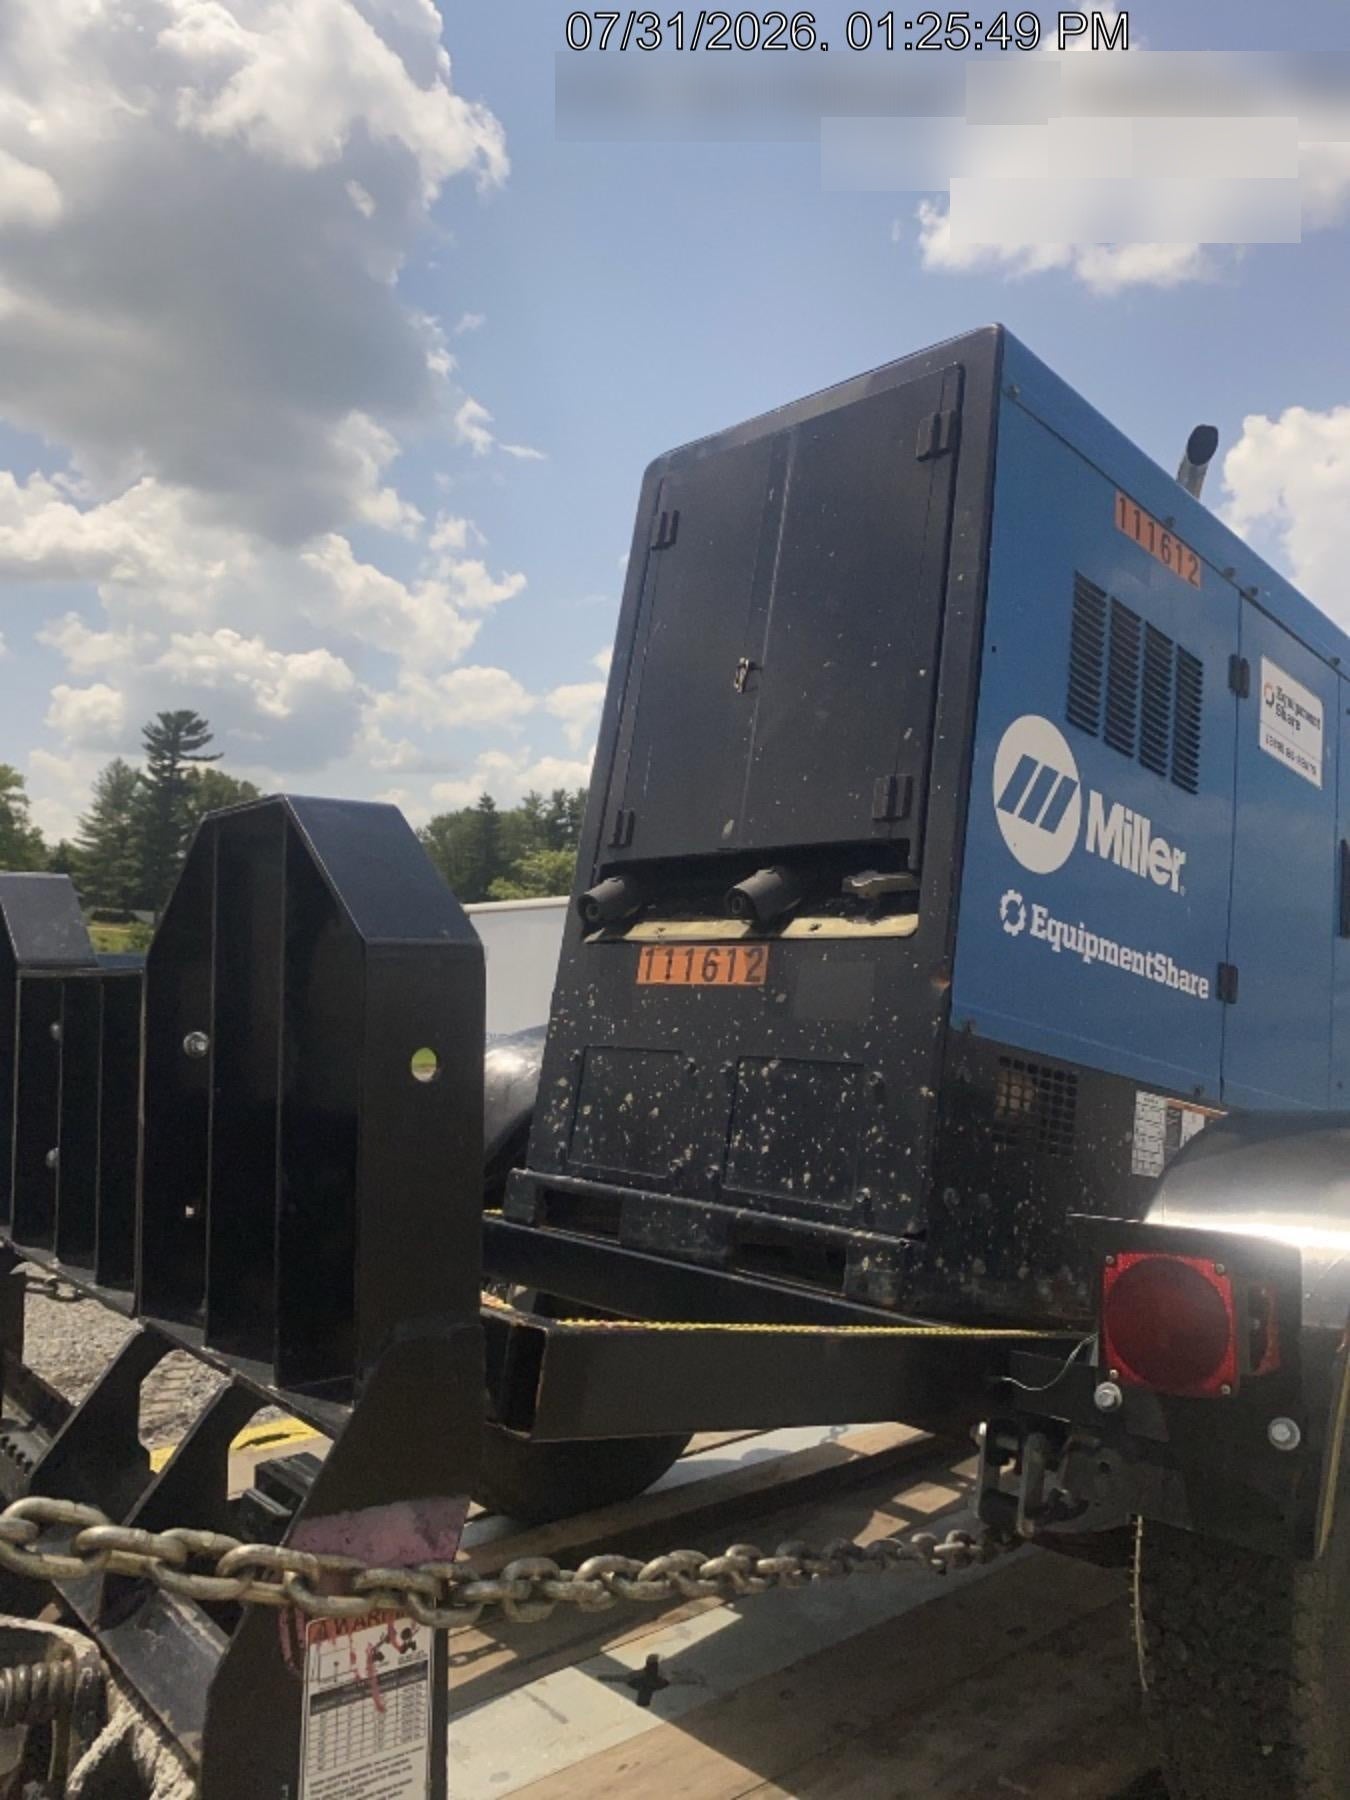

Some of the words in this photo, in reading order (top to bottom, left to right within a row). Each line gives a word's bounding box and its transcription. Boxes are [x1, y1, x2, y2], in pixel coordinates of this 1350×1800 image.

[1119, 497, 1200, 588] 111612
[1085, 789, 1187, 893] Miller
[642, 948, 763, 983] 111612
[1029, 903, 1209, 999] EquipmentShare
